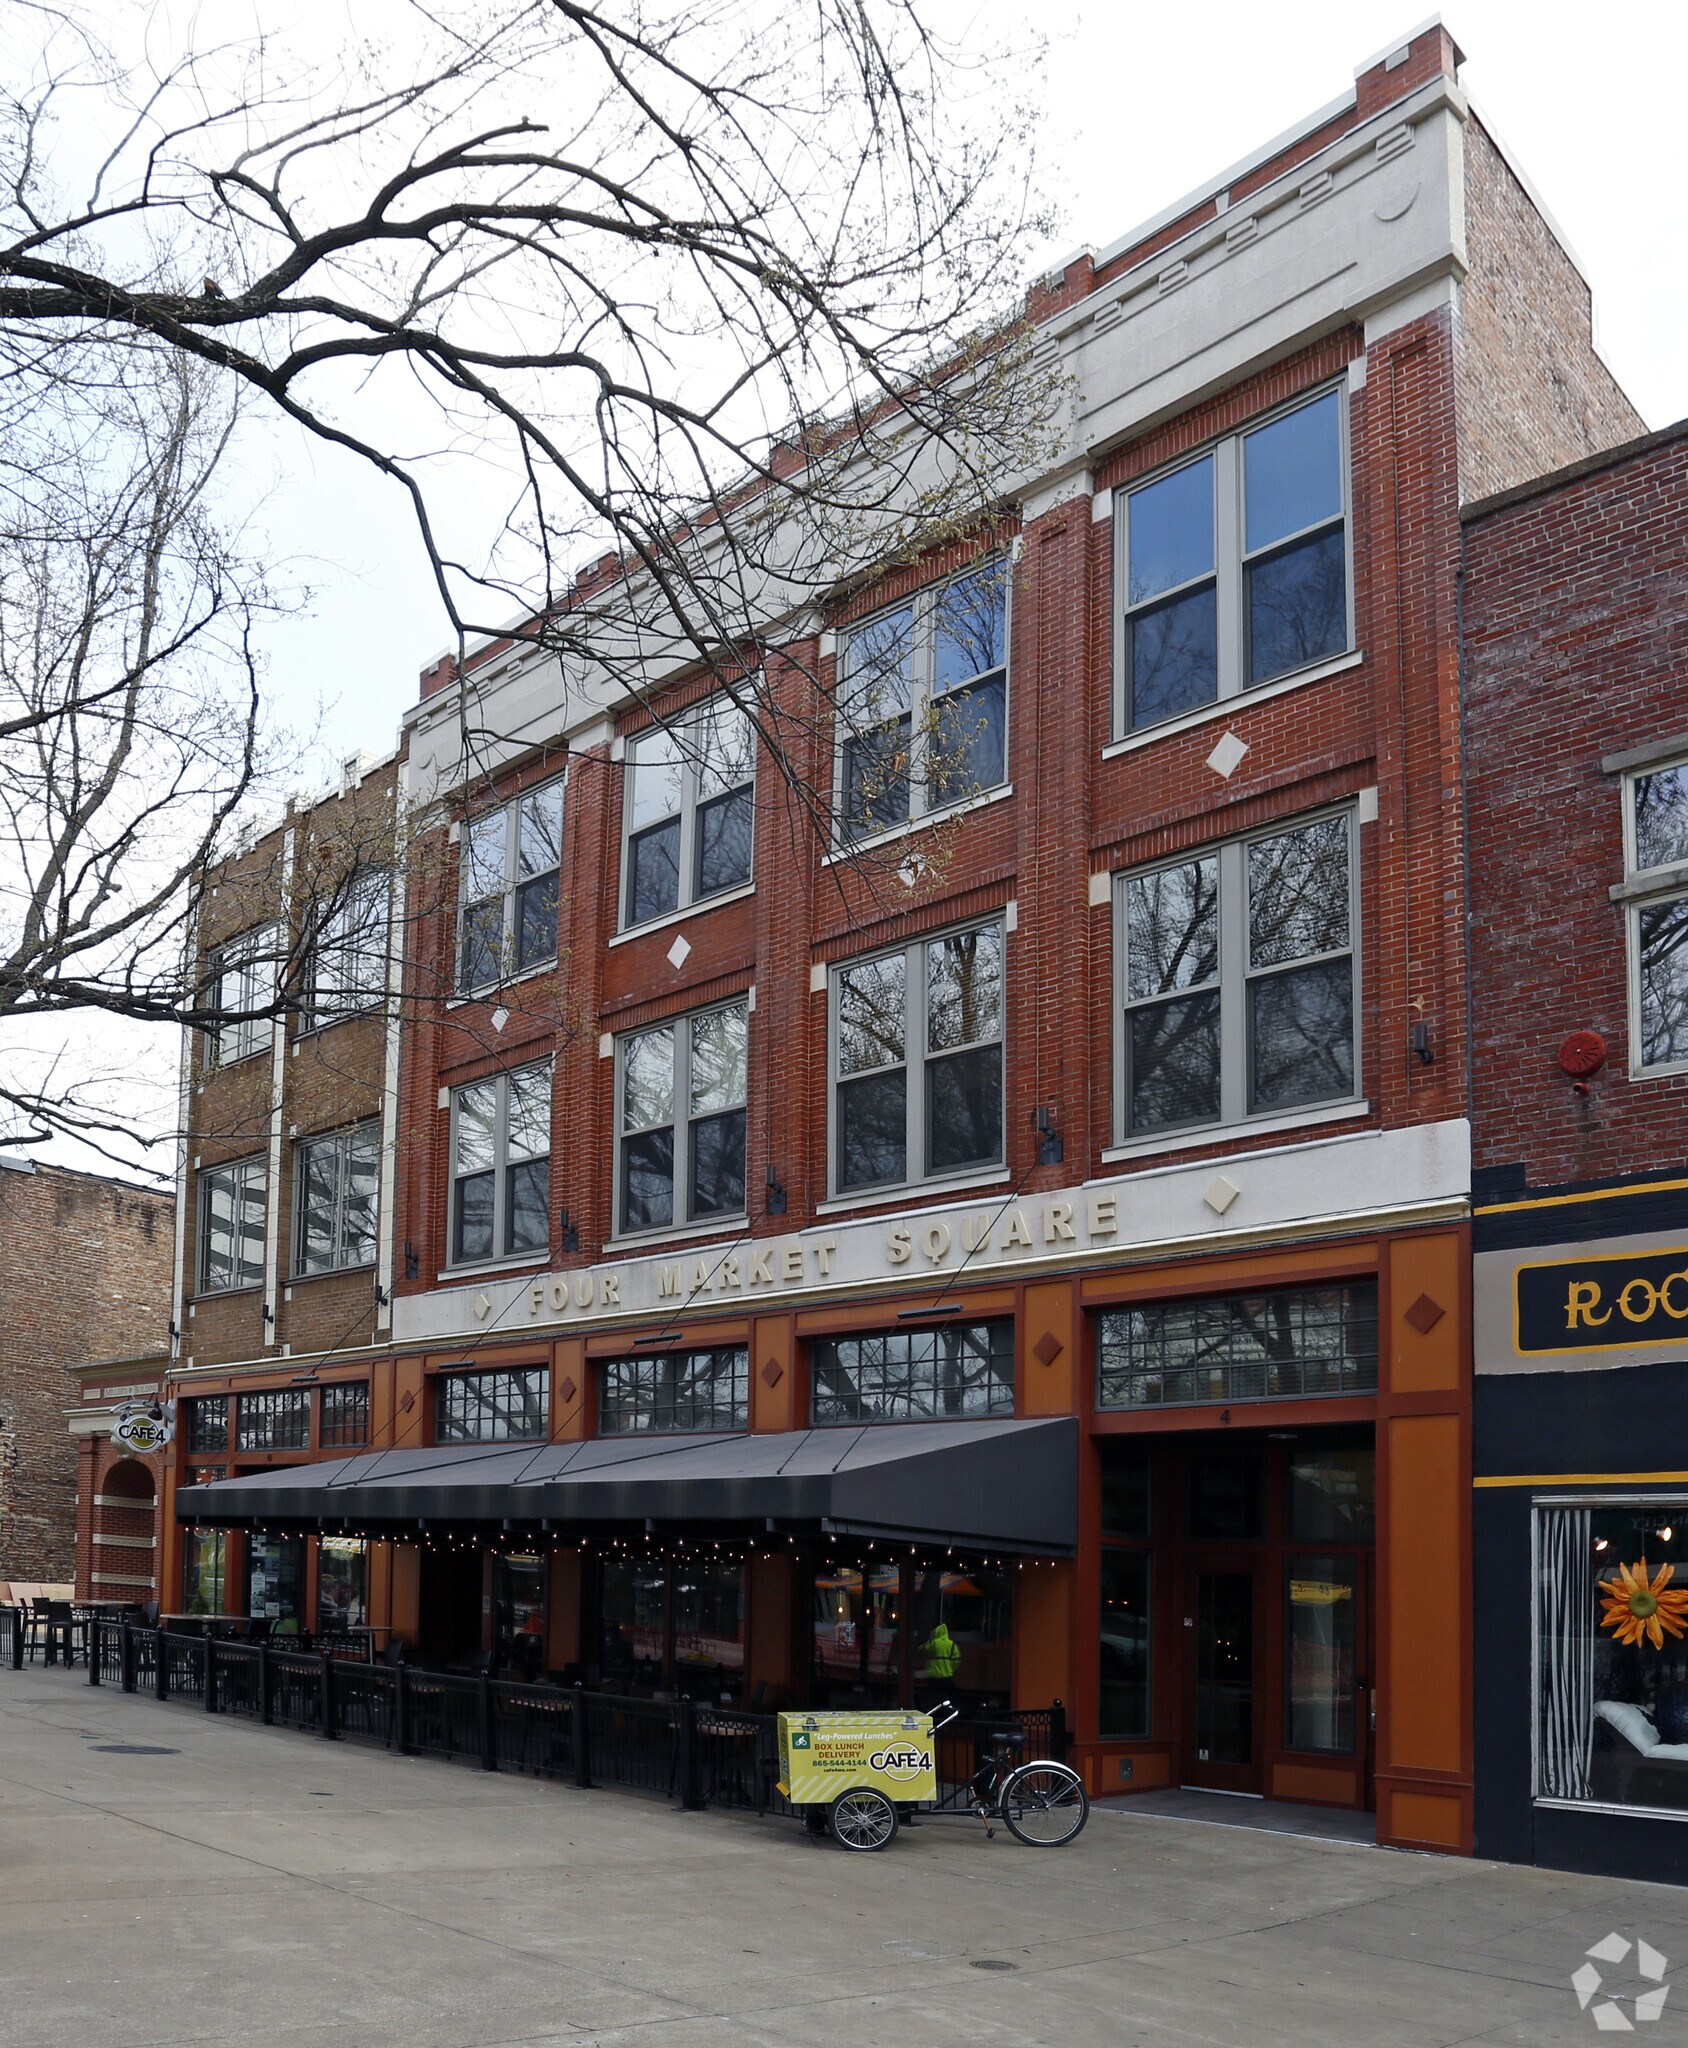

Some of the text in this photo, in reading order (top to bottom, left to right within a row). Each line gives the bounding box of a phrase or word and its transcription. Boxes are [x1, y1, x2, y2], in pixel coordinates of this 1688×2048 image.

[529, 1194, 1118, 1314] FOUR MARKET SQUARE
[1220, 1408, 1231, 1425] 4
[118, 1424, 166, 1443] CAFÉ 4
[814, 1743, 833, 1751] BOX
[818, 1751, 861, 1759] DELIVERY
[869, 1749, 933, 1771] CAFÉ 4
